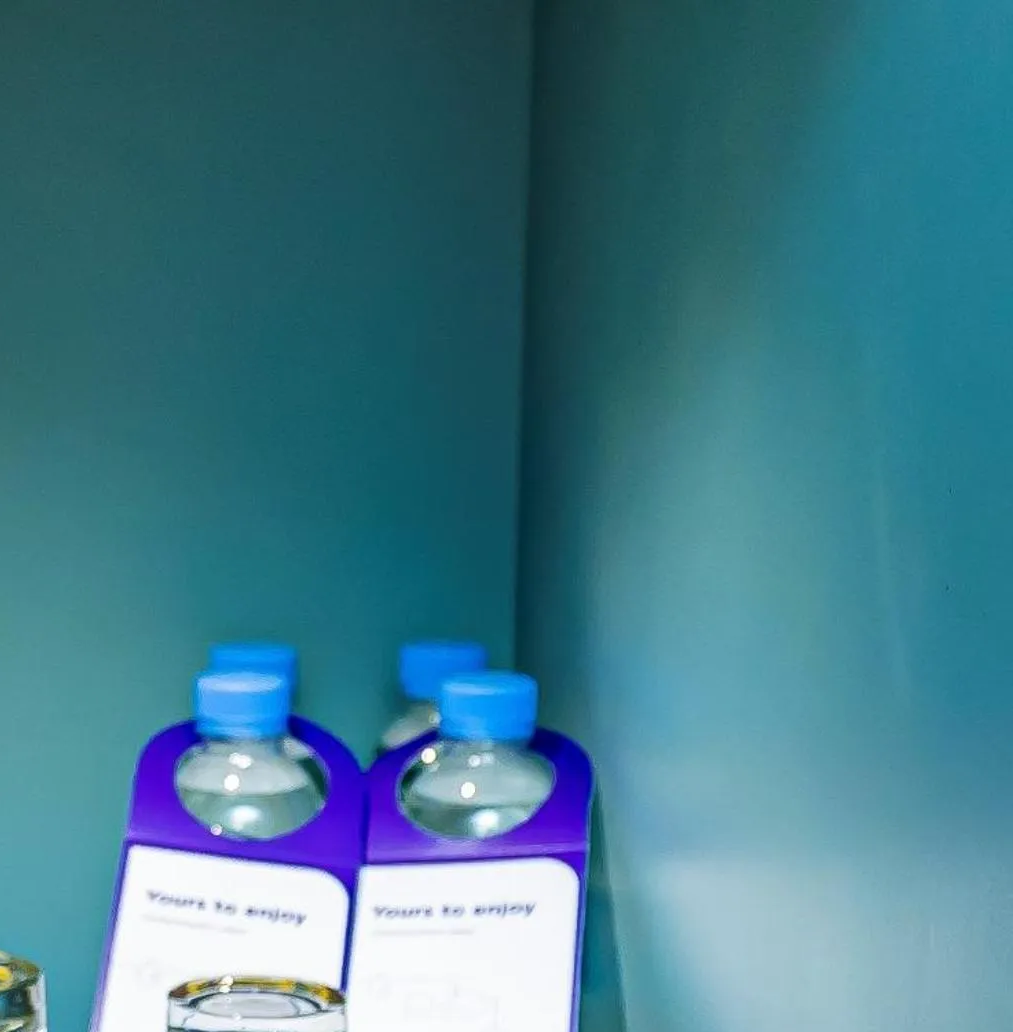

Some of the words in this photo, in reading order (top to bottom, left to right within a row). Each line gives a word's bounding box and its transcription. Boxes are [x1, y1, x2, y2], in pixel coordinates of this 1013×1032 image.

[146, 889, 207, 911] Yours
[214, 898, 237, 915] to
[244, 904, 308, 928] enjoy
[372, 903, 434, 919] Yours
[441, 903, 466, 917] to
[473, 902, 537, 918] enjoy
